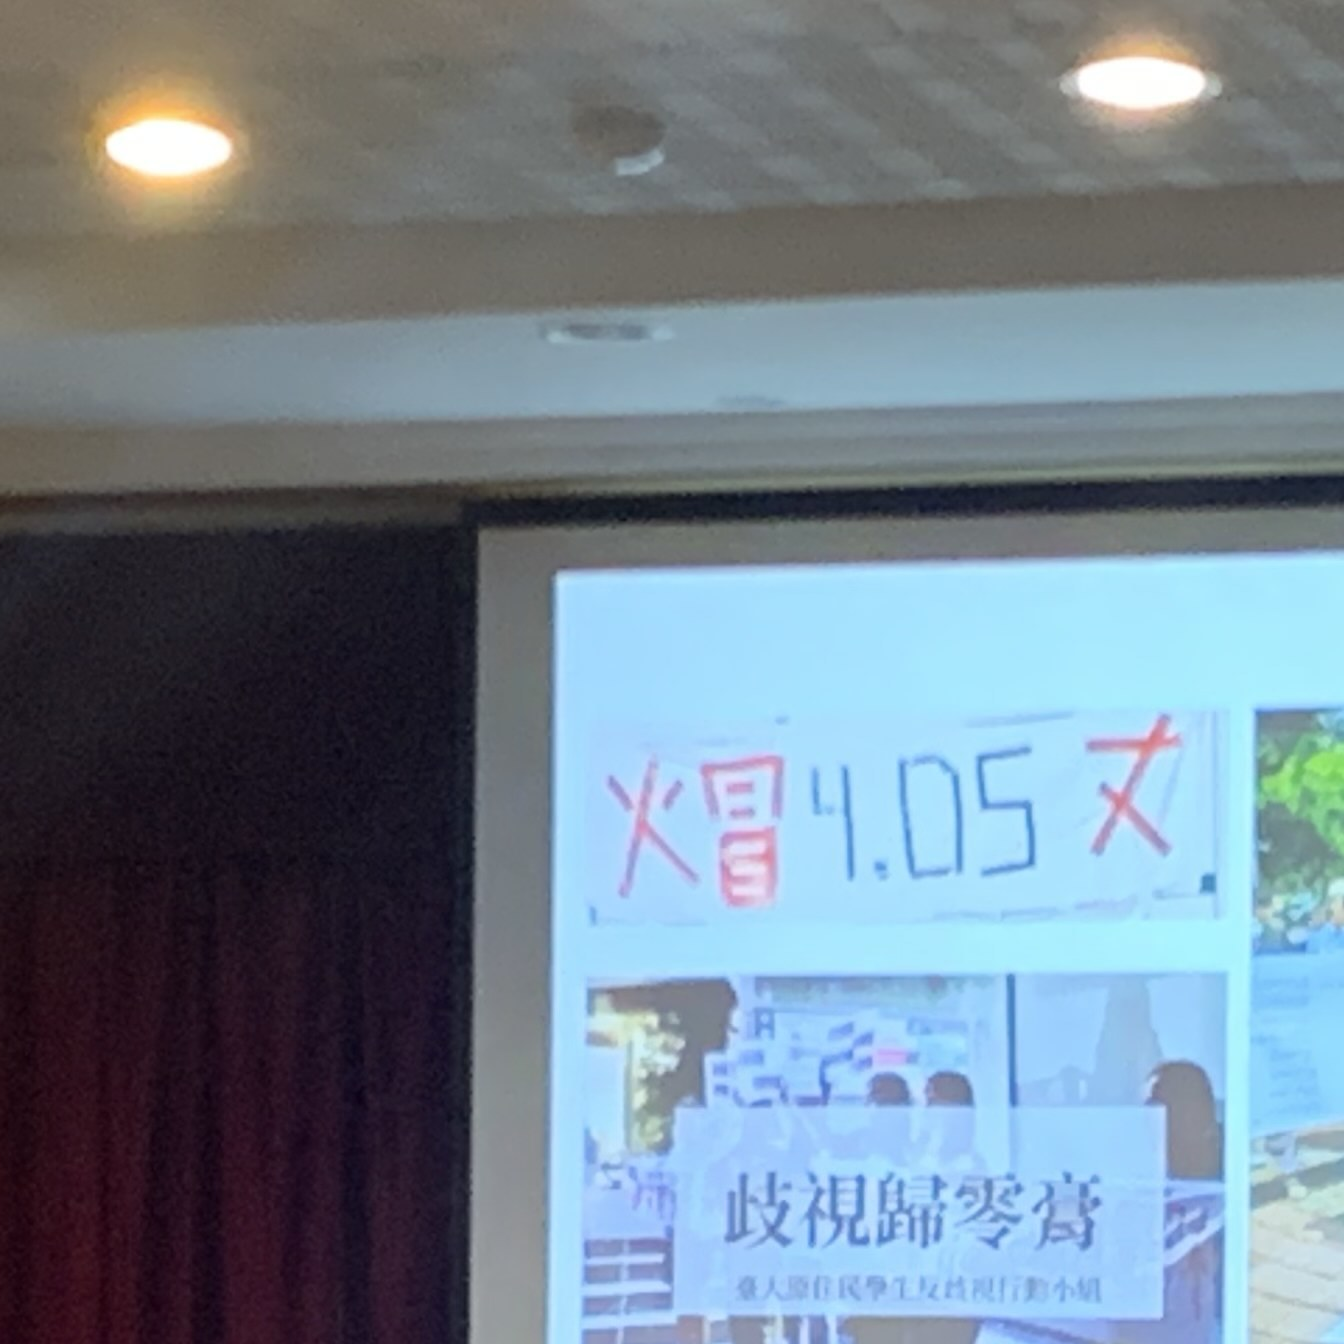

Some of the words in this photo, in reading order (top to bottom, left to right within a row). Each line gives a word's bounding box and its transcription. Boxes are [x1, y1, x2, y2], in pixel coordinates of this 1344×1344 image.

[723, 1171, 1103, 1252] 歧視歸零膏
